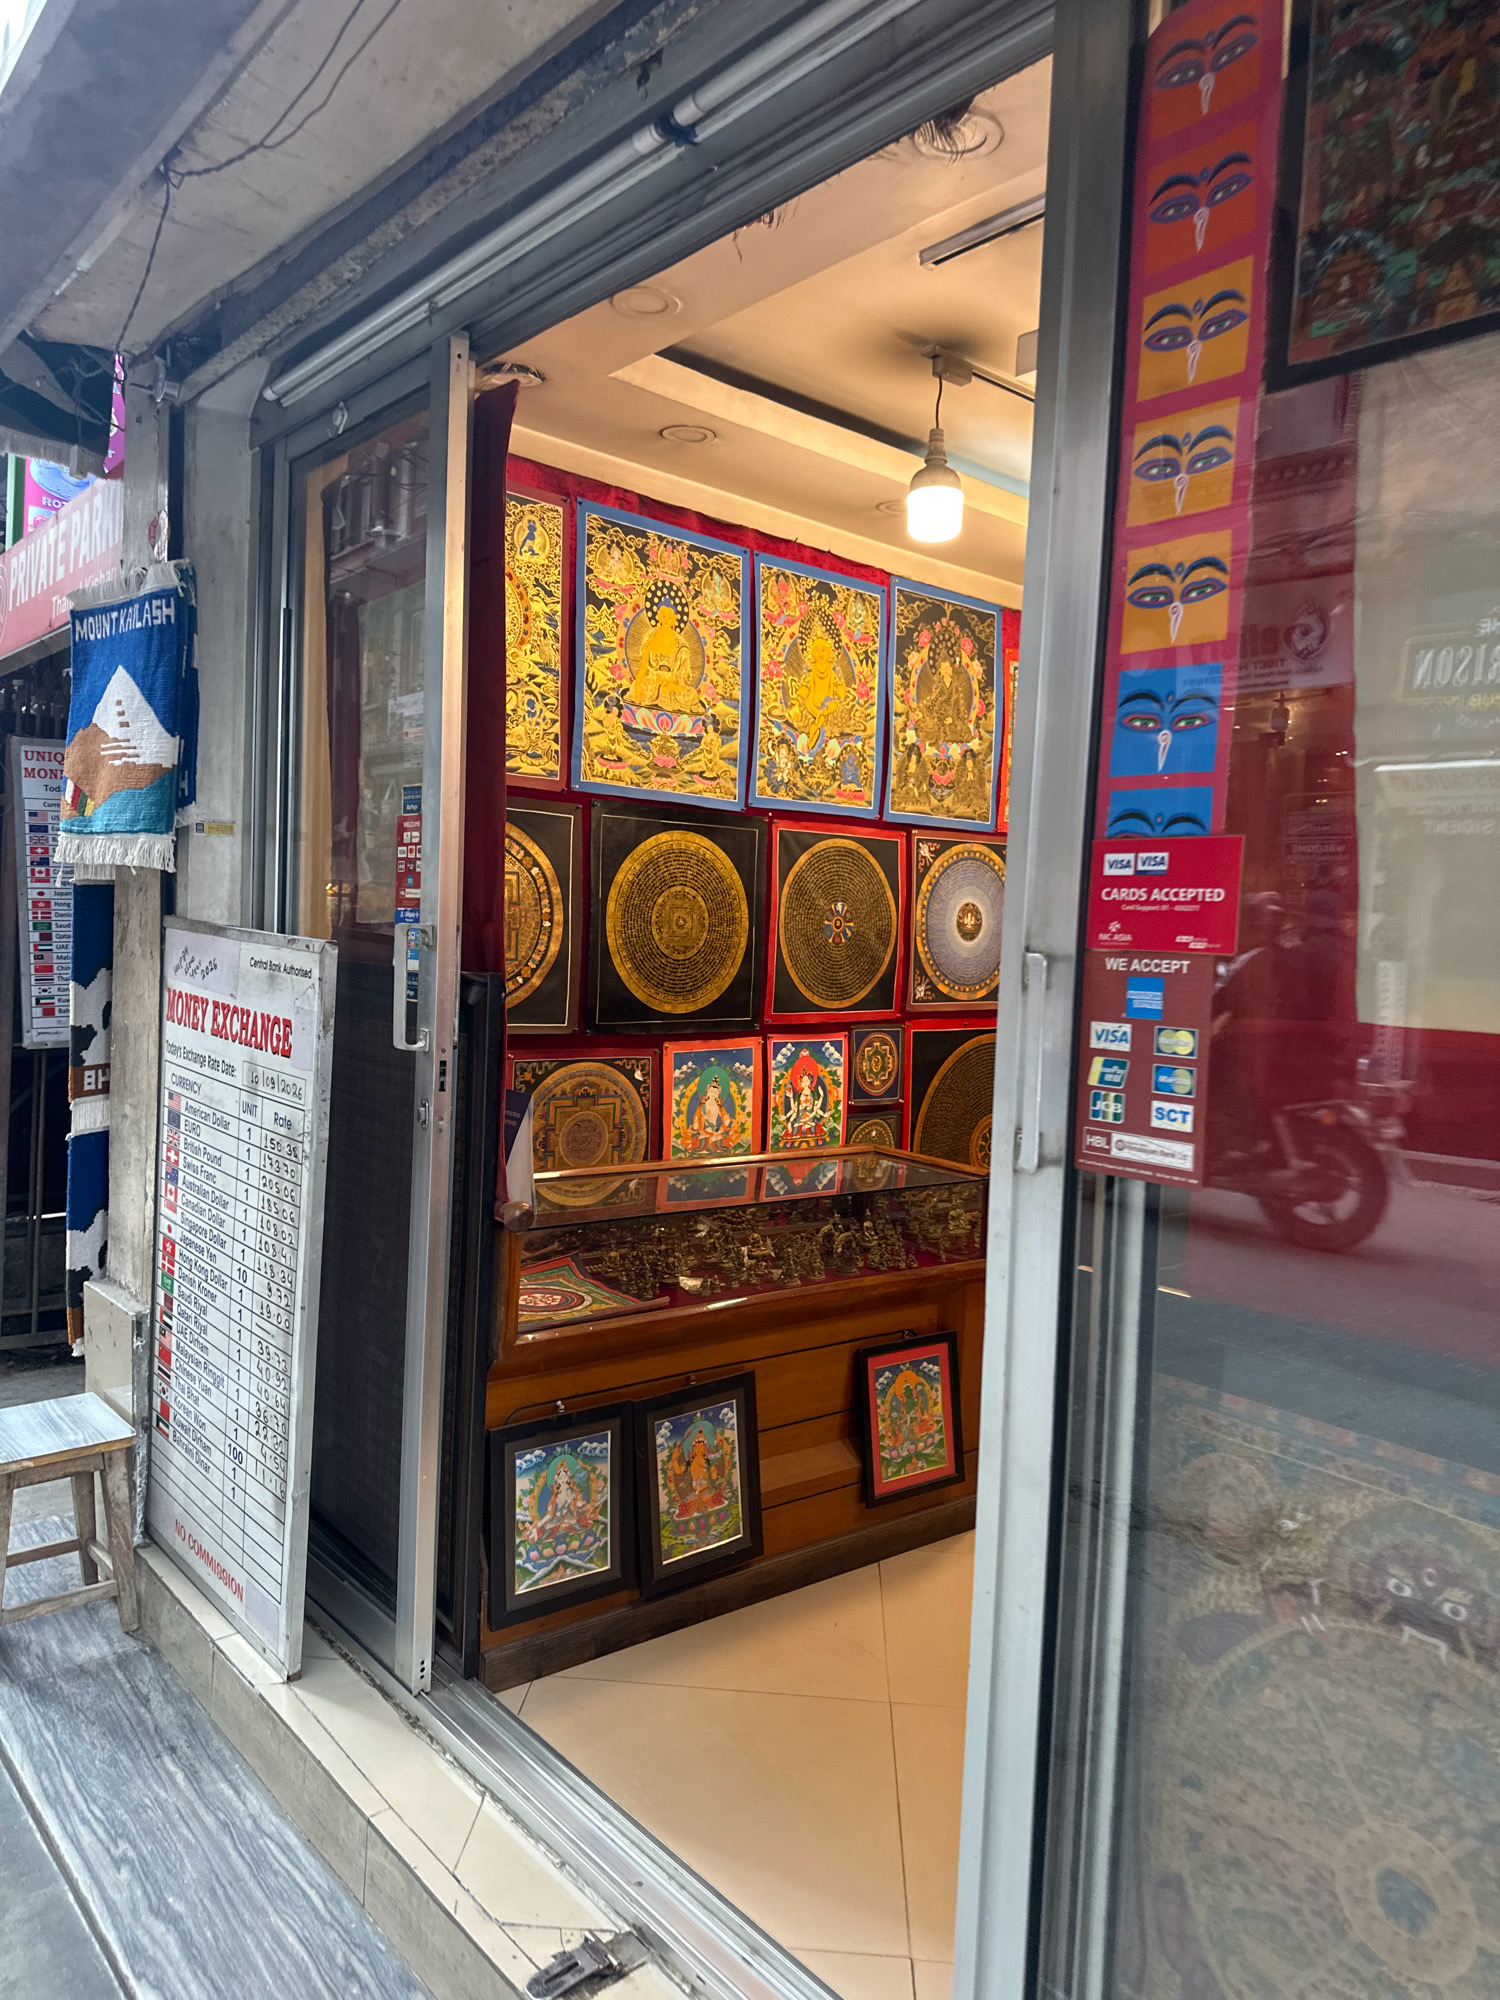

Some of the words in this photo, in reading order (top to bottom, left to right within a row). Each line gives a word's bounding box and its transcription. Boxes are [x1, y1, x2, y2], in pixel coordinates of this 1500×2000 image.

[8, 521, 68, 611] PRIVATE
[75, 611, 118, 642] MOUNT
[119, 597, 175, 633] KAILASH
[1107, 859, 1132, 870] VISA
[1140, 855, 1166, 867] VISA
[1101, 887, 1148, 901] CARDS
[1150, 887, 1226, 902] ACCEPTED
[200, 957, 218, 981] 2026
[249, 956, 269, 969] Central
[268, 960, 282, 973] Bank
[282, 964, 313, 980] Authorised
[1105, 957, 1129, 971] WE
[1129, 958, 1191, 974] ACCEPT
[166, 987, 210, 1033] MONEY
[210, 1000, 293, 1059] EXCHANGE
[1094, 1028, 1129, 1045] VISA
[166, 1040, 183, 1059] Today's
[182, 1046, 207, 1068] Exchange
[207, 1055, 221, 1071] Rate
[221, 1059, 237, 1078] Date:
[171, 1072, 202, 1094] CURRENCY
[241, 1100, 258, 1118] UNIT
[273, 1112, 292, 1131] Rate
[184, 1101, 211, 1122] American
[211, 1109, 231, 1131] Dollar
[247, 1127, 252, 1141] 1
[1090, 1100, 1122, 1113] JCB
[1154, 1107, 1190, 1125] SCT
[183, 1137, 202, 1157] British
[202, 1144, 222, 1167] Pound
[245, 1167, 250, 1181] 1
[184, 1119, 201, 1138] EURO
[246, 1147, 251, 1161] 1
[1086, 1134, 1111, 1149] HBL
[182, 1157, 199, 1175] Swiss
[200, 1164, 217, 1185] Franc
[244, 1187, 249, 1201] 1
[182, 1175, 210, 1202] Australian
[210, 1189, 229, 1211] Dollar
[243, 1208, 248, 1221] 1
[180, 1211, 209, 1240] Singapore
[208, 1227, 228, 1250] Dollar
[240, 1248, 246, 1262] 1
[181, 1193, 207, 1217] Canadian
[207, 1206, 226, 1228] Dollar
[242, 1228, 247, 1242] 1
[178, 1249, 193, 1269] Hong
[193, 1259, 209, 1282] Kong
[209, 1268, 229, 1291] Dollar
[238, 1288, 243, 1302] 1
[179, 1230, 205, 1255] Japanese
[205, 1246, 217, 1264] Yen
[237, 1266, 248, 1284] 10
[177, 1284, 193, 1306] Saudi
[193, 1296, 208, 1318] Riyal
[237, 1329, 242, 1342] 1
[178, 1266, 197, 1290] Danish
[198, 1279, 217, 1304] Kroner
[238, 1309, 242, 1322] 1
[176, 1321, 188, 1341] UAE
[188, 1330, 210, 1357] Dirham
[236, 1368, 241, 1382] 1
[177, 1303, 193, 1325] Qatari
[193, 1315, 208, 1337] Riyal
[236, 1349, 241, 1362] 1
[175, 1340, 202, 1370] Malaysian
[203, 1358, 225, 1389] Ringgit
[235, 1388, 240, 1401] 1
[175, 1358, 197, 1385] Chinese
[197, 1373, 212, 1399] Yuan
[234, 1408, 239, 1422] 1
[173, 1395, 193, 1422] Korean
[193, 1409, 207, 1433] Won
[227, 1443, 244, 1465] 100
[174, 1375, 186, 1395] Thai
[186, 1383, 200, 1405] Bhat
[233, 1428, 238, 1441] 1
[172, 1430, 196, 1459] Bahraini
[195, 1448, 211, 1473] Dinar
[231, 1486, 236, 1500] 1
[173, 1412, 192, 1436] Kuwait
[191, 1425, 212, 1457] Dirham
[231, 1467, 237, 1481] 1
[175, 1519, 186, 1542] NO
[188, 1533, 244, 1603] COMMISSION
